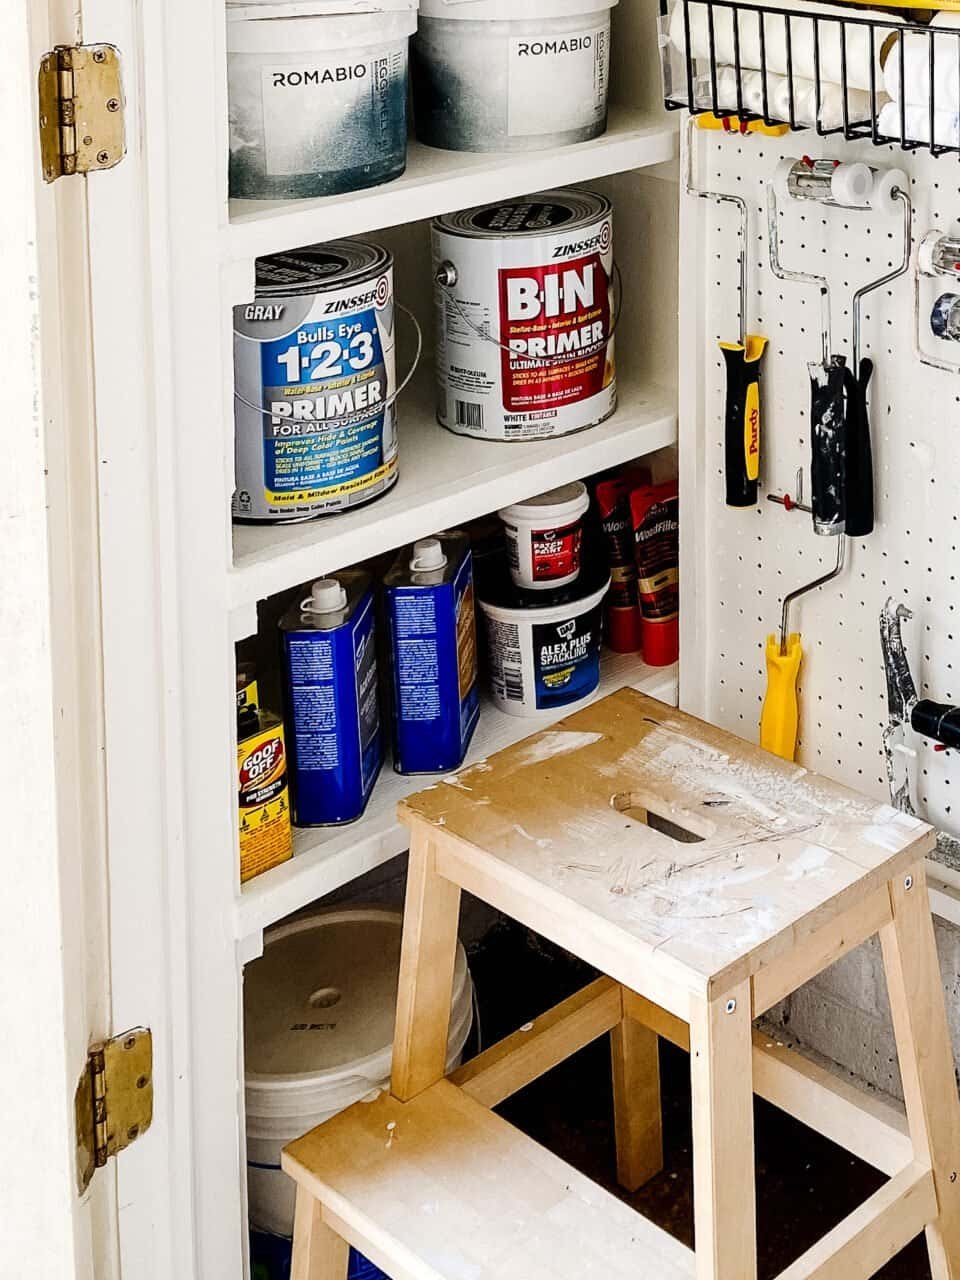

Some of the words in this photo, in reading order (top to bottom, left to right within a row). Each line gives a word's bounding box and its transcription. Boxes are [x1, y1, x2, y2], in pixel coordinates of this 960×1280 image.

[518, 36, 592, 56] ROMABIO
[272, 64, 366, 88] ROMABIO
[552, 234, 602, 258] ZINSSER
[244, 304, 284, 321] GRAY
[324, 290, 378, 314] ZINSSER
[297, 328, 334, 344] Bulls
[338, 323, 362, 339] Eye
[508, 320, 604, 360] PRIMER
[510, 359, 550, 371] ULTIMATE
[271, 382, 382, 425] PRIMER
[504, 414, 528, 422] WHITE
[273, 424, 301, 436] FOR
[306, 422, 329, 434] ALL
[749, 408, 758, 455] Purdy
[274, 438, 315, 449] Improves
[318, 433, 337, 443] Hide
[286, 446, 309, 456] Deep
[559, 622, 574, 635] DAP
[541, 642, 568, 656] ALEX
[570, 632, 592, 650] PLUS
[540, 646, 587, 666] SPACKLING
[243, 738, 280, 770] GOOF
[249, 754, 275, 779] OFF
